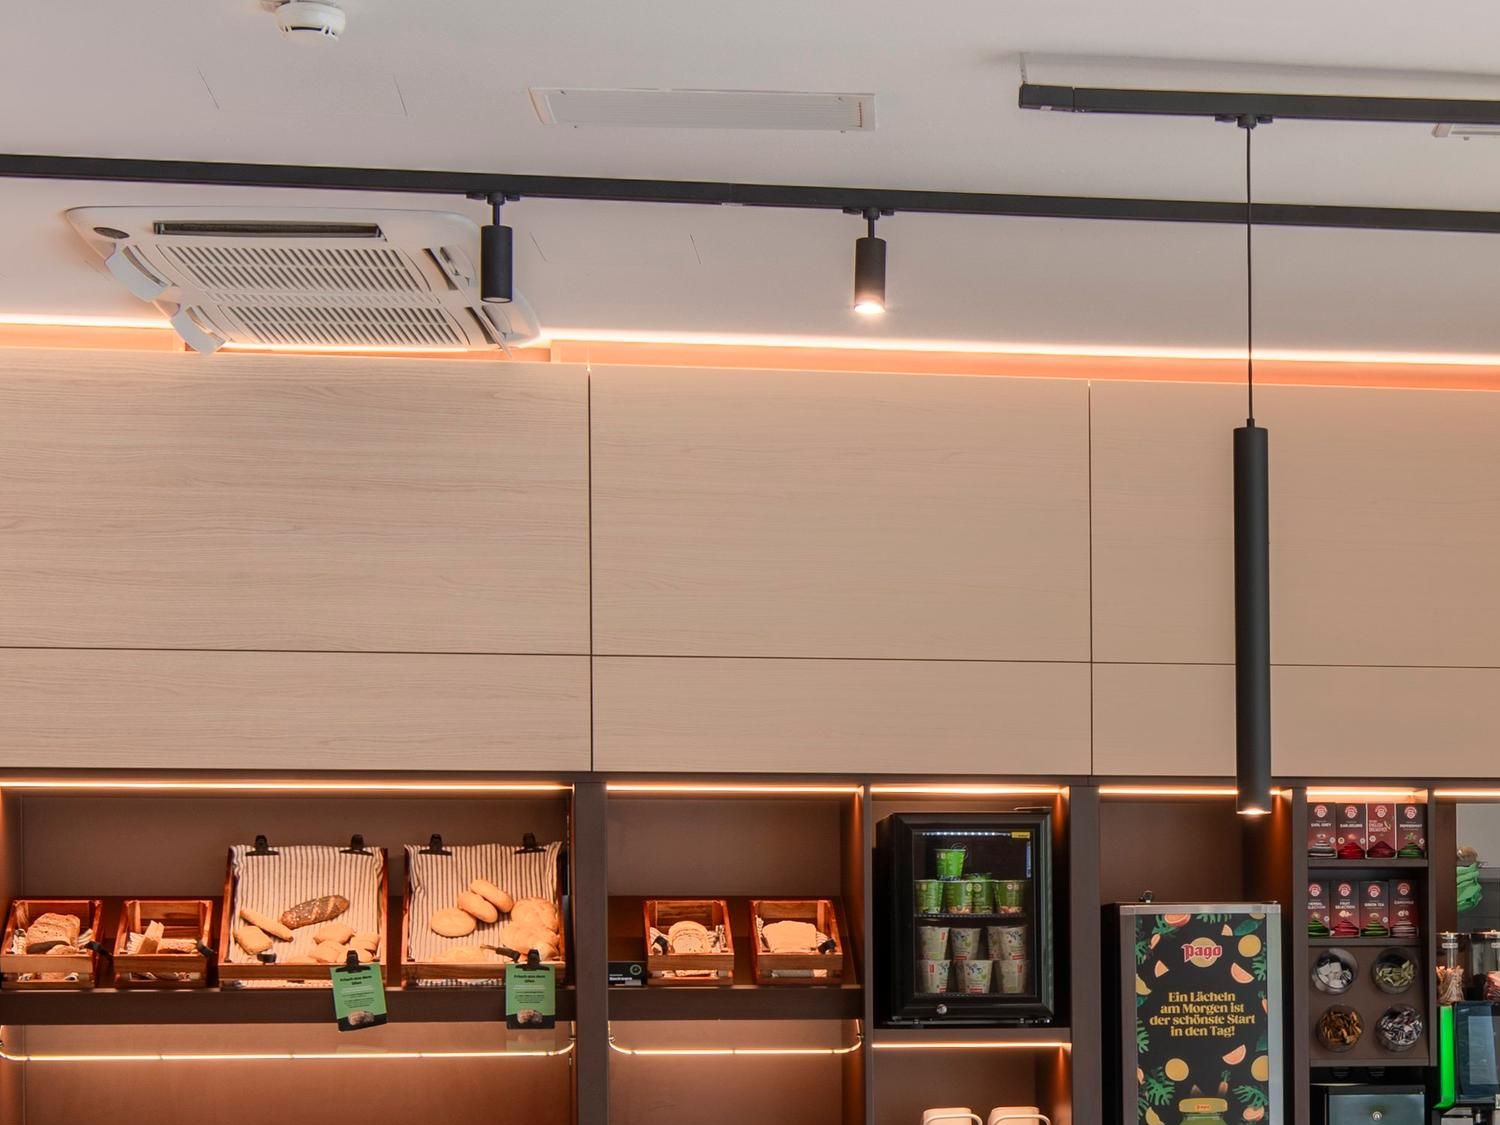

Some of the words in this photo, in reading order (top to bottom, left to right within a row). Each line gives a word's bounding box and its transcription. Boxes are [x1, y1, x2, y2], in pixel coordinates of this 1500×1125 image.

[1181, 943, 1223, 963] pago
[1168, 991, 1188, 1002] Ein
[1190, 991, 1236, 1002] Lächeln
[1160, 1005, 1180, 1014] am
[1182, 1004, 1228, 1015] Morgen
[1230, 1002, 1245, 1013] ist
[1149, 1015, 1171, 1026] der
[1172, 1014, 1225, 1025] schönste
[1227, 1014, 1256, 1025] Start
[1170, 1026, 1183, 1037] in
[1184, 1026, 1208, 1037] den
[1210, 1026, 1236, 1038] Tag!
